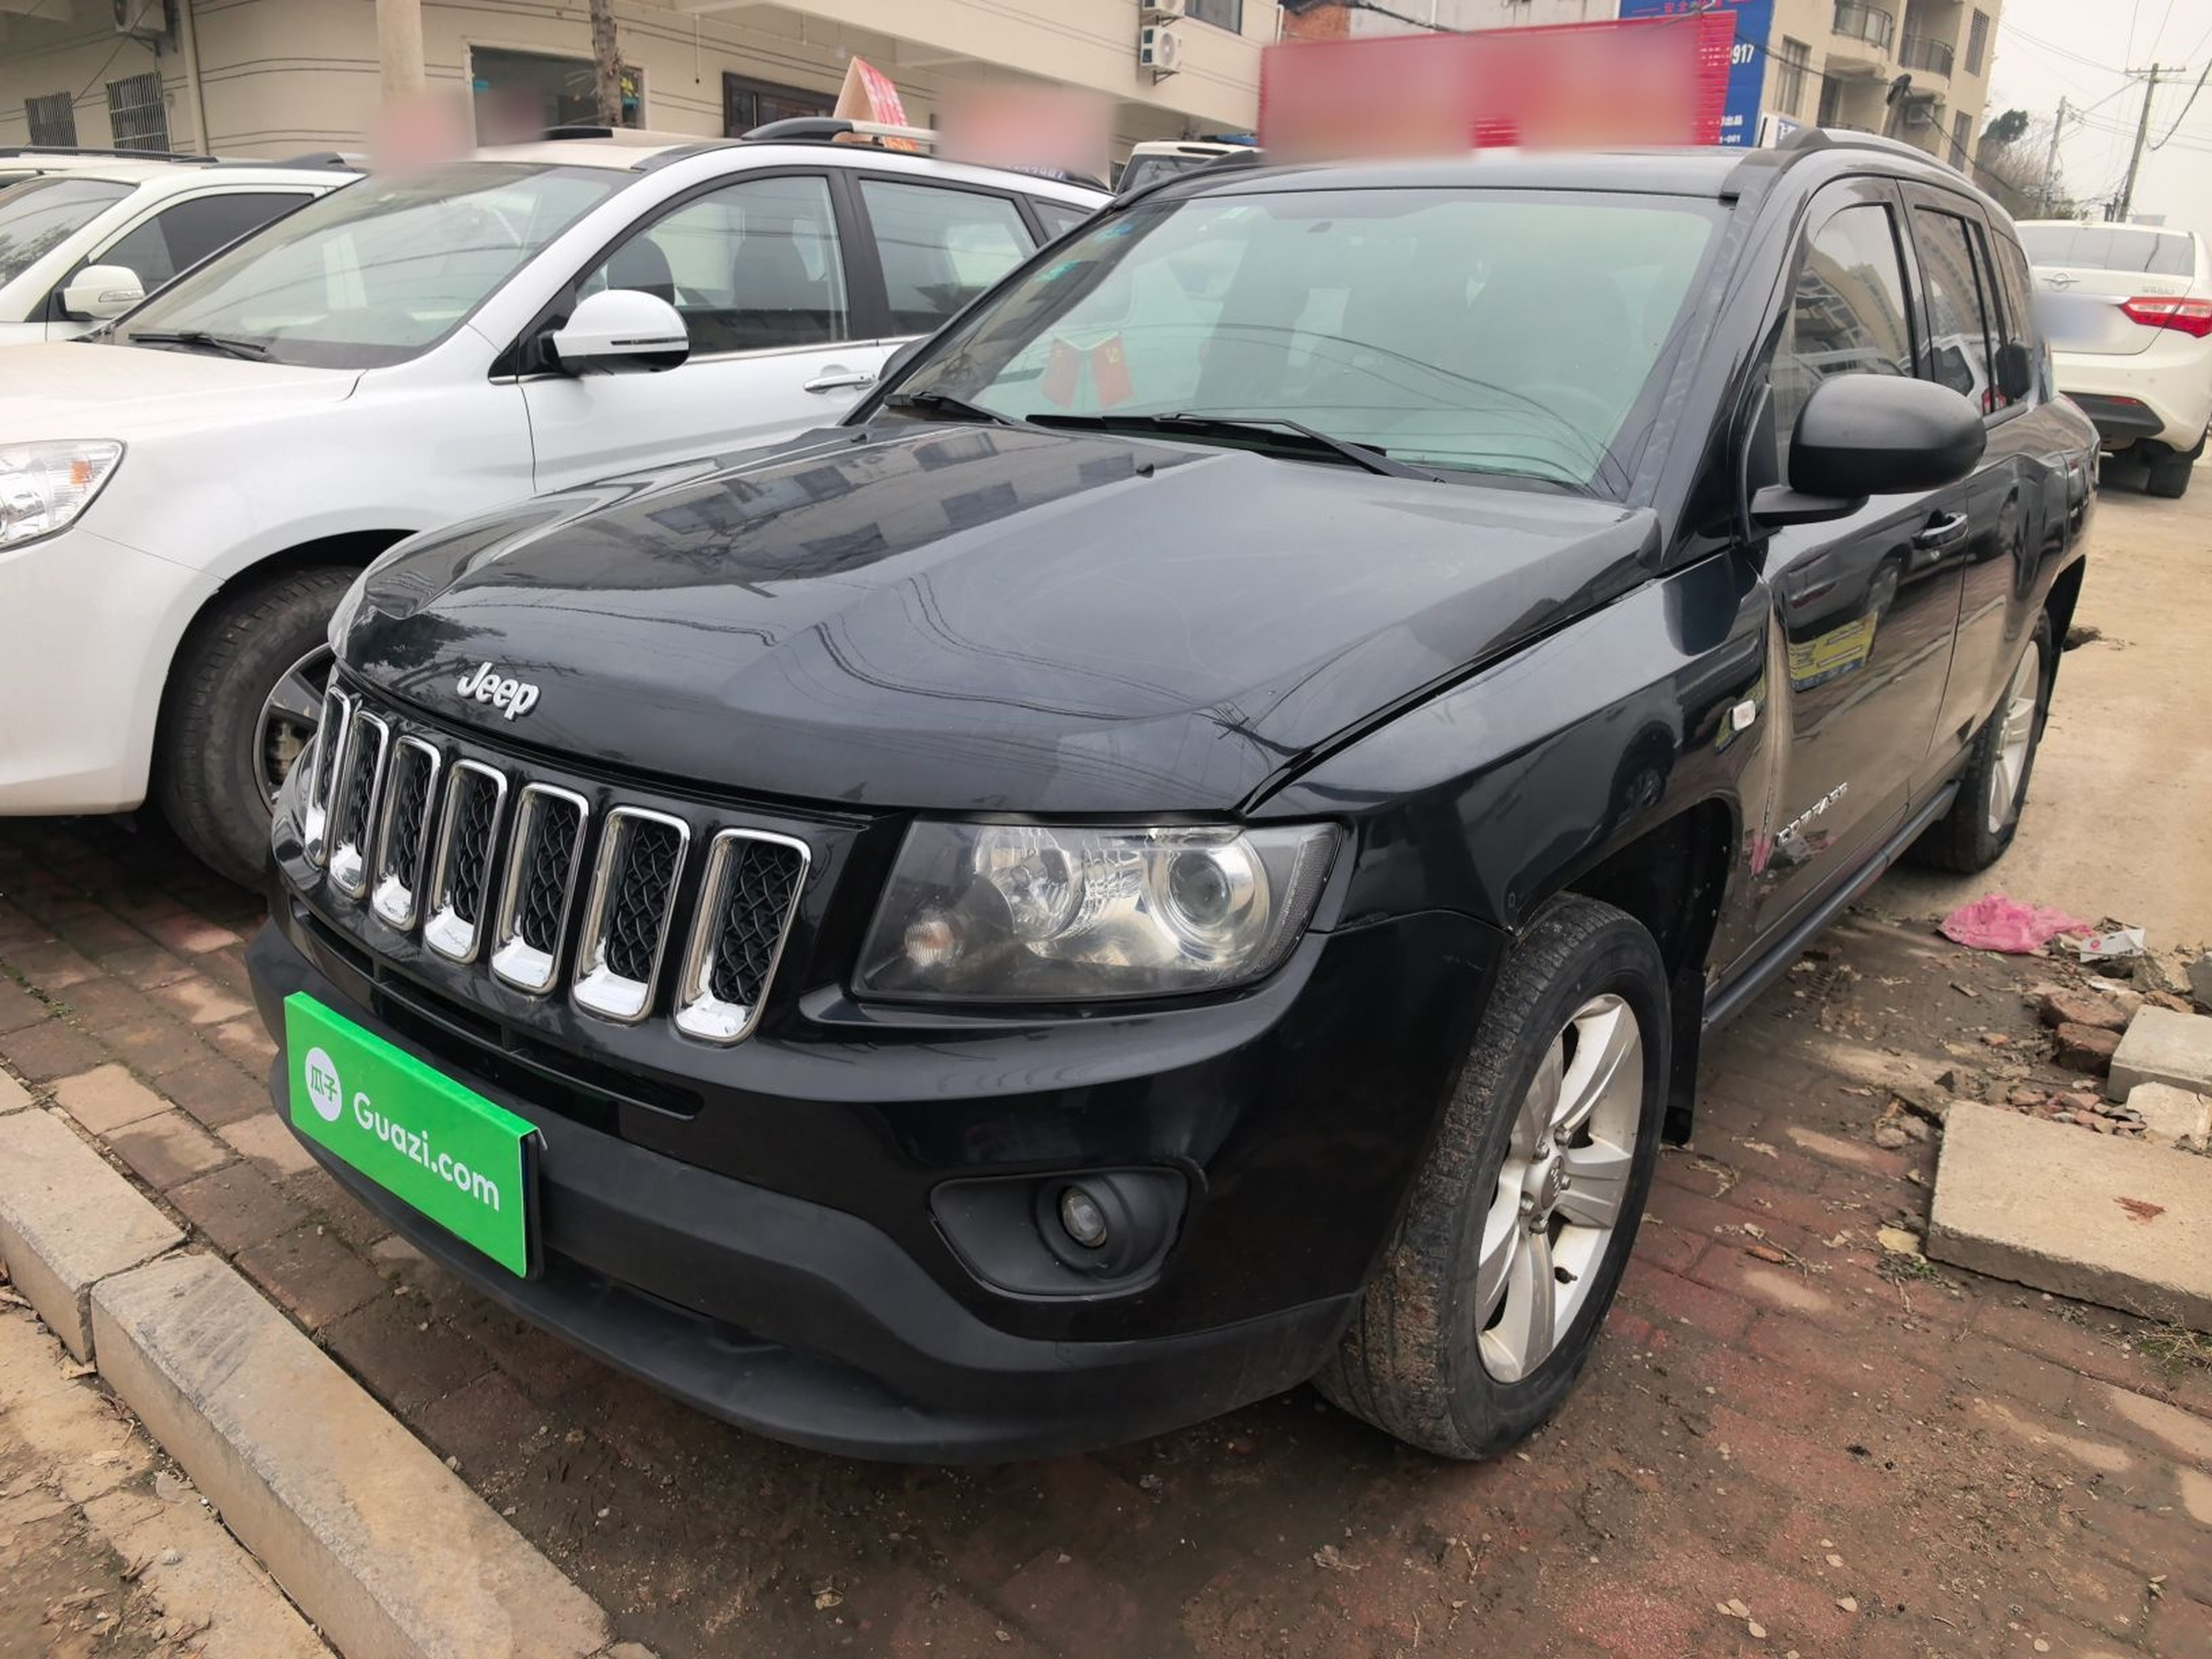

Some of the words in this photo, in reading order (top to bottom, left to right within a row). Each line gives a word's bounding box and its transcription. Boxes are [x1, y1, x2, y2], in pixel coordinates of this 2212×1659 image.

[1729, 43, 1755, 65] 917
[456, 661, 540, 721] Jeep
[310, 1065, 338, 1105] 瓜子
[353, 1091, 500, 1213] Guazi.com
